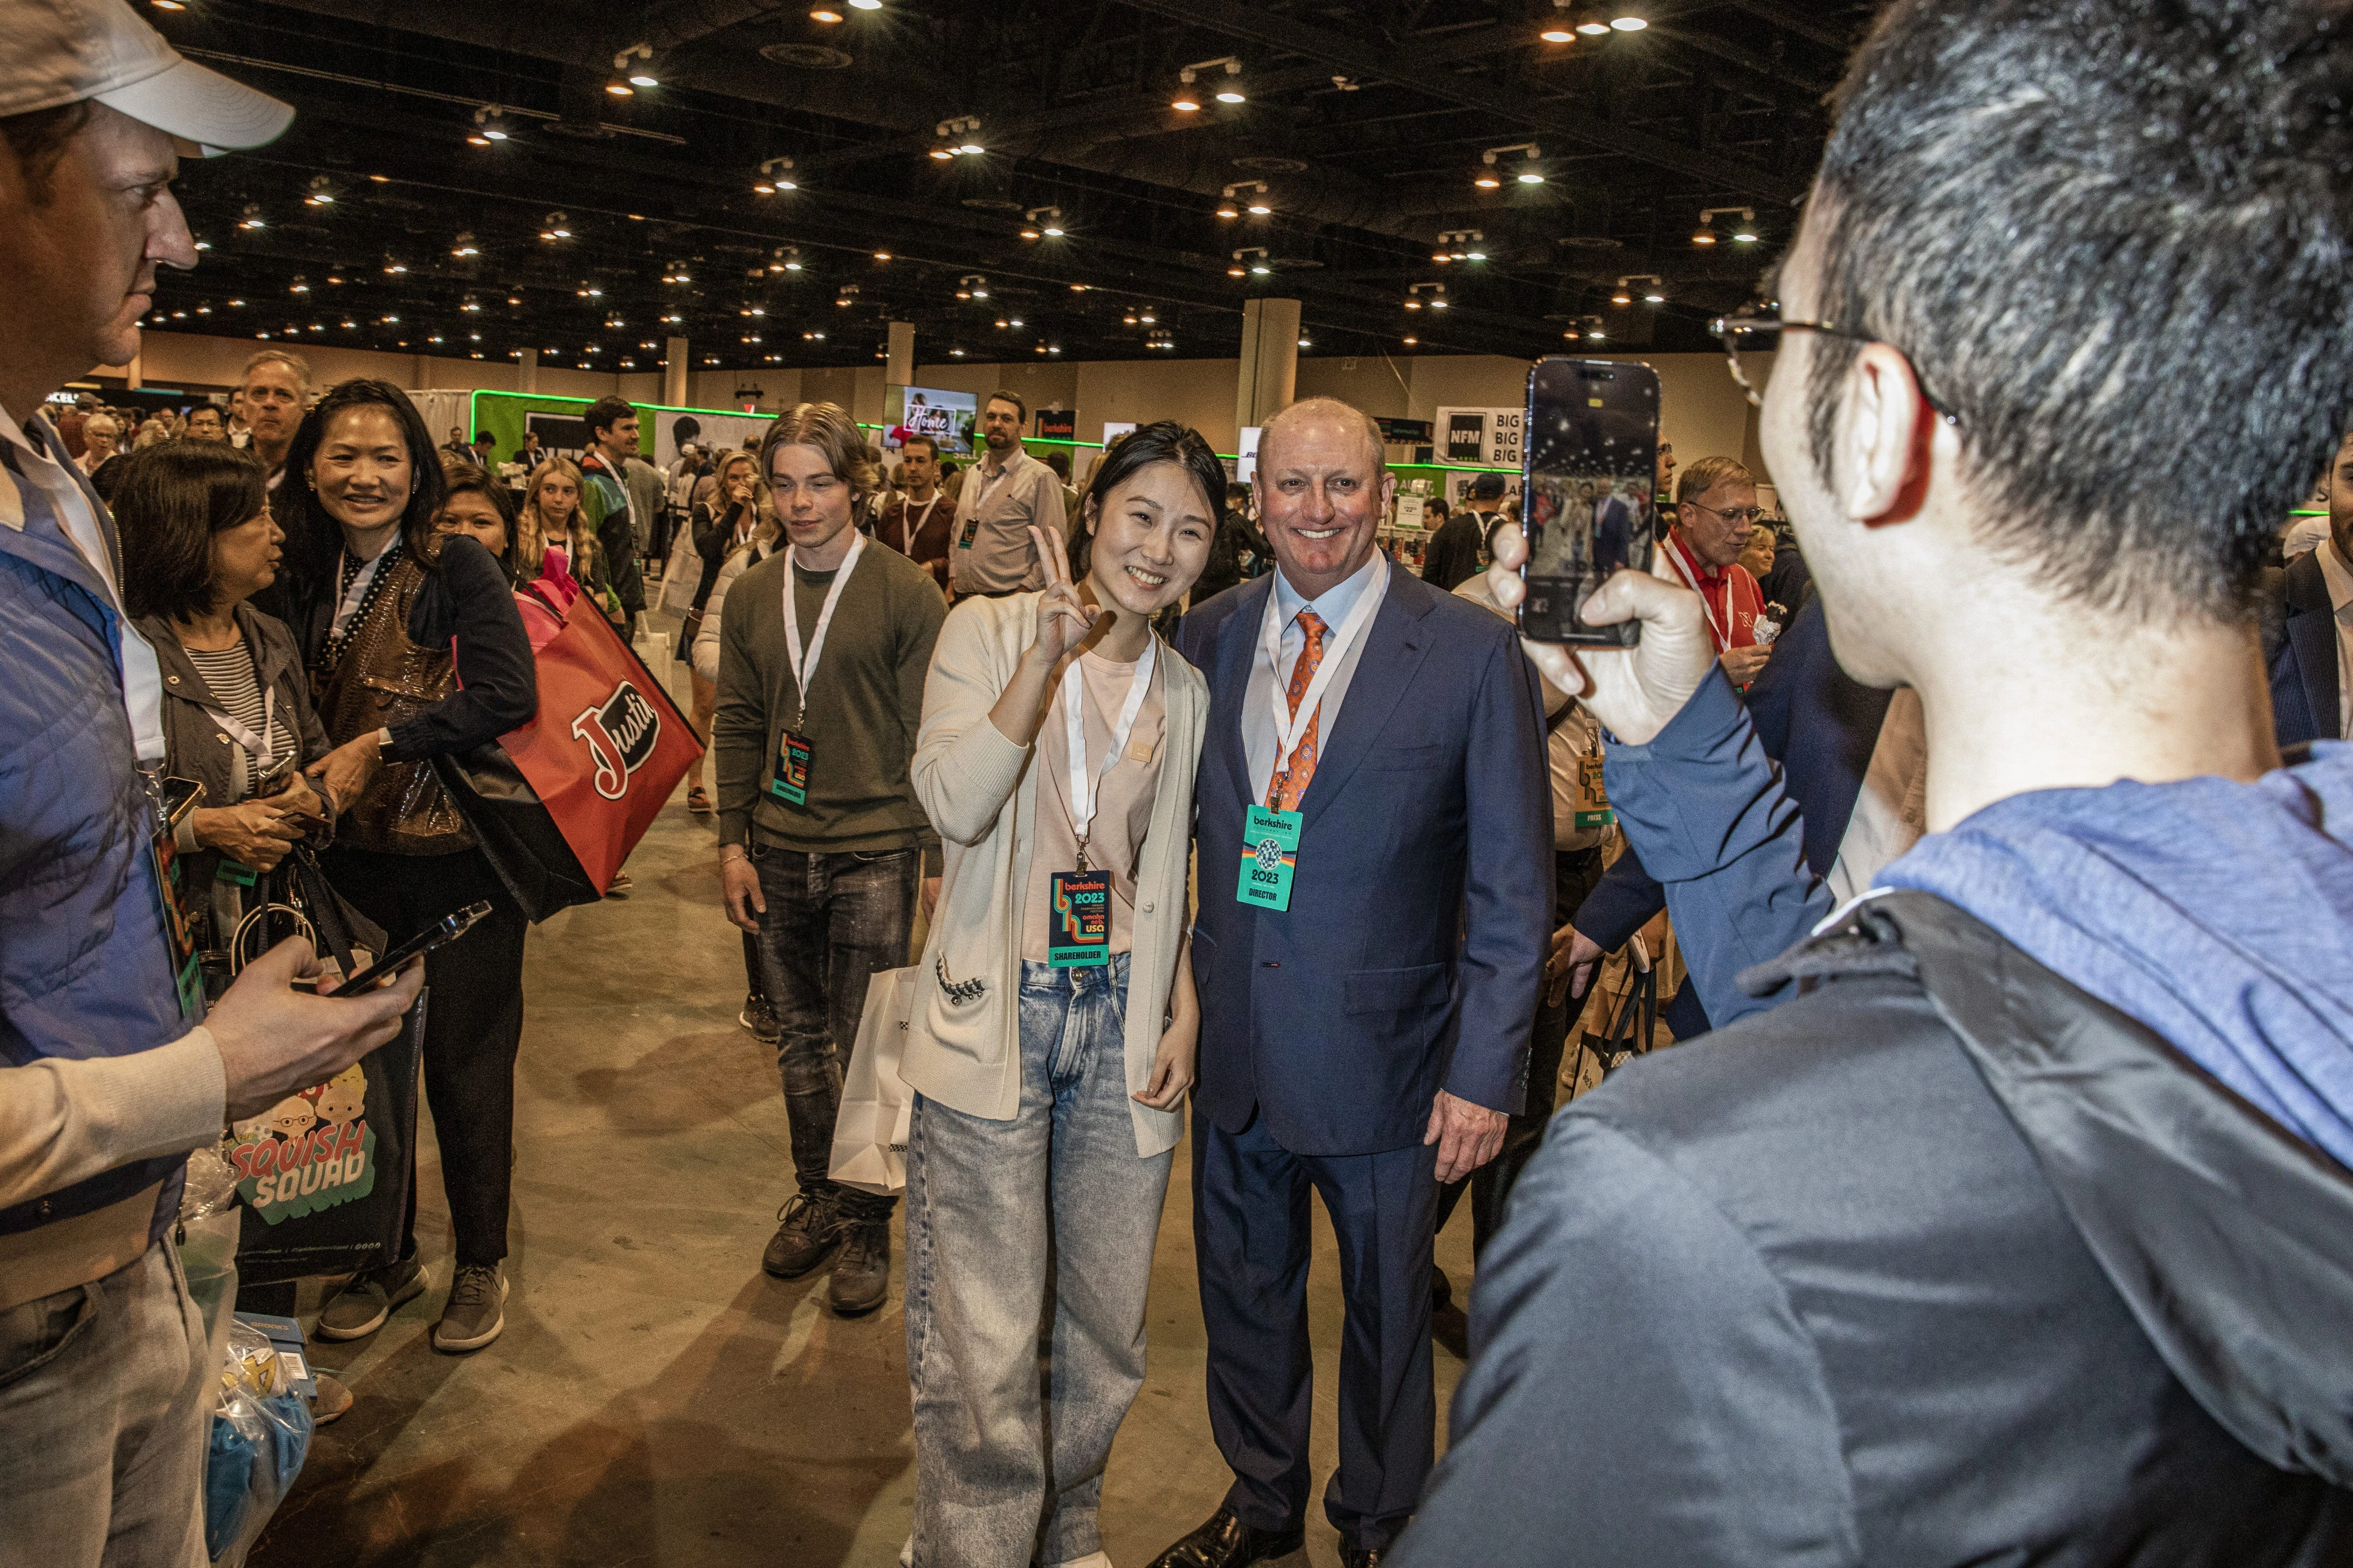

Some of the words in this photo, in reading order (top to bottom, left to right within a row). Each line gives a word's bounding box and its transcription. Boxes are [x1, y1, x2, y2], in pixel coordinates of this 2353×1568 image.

[908, 404, 947, 430] Home
[1497, 415, 1519, 427] BIG
[1451, 430, 1480, 444] NFM
[1495, 432, 1518, 445] BIG
[1494, 449, 1517, 462] BIG
[571, 693, 655, 800] Justin
[792, 748, 809, 760] 2023
[1254, 815, 1293, 831] berkshire
[1251, 869, 1279, 885] 2023
[1065, 881, 1105, 891] berkshire
[1075, 893, 1105, 903] 2023
[1249, 887, 1277, 901] DIRECTOR
[1086, 924, 1105, 933] usa
[1054, 951, 1101, 961] SHAREHOLDER
[231, 1119, 367, 1181] SQUISH
[253, 1151, 365, 1208] SQUAD
